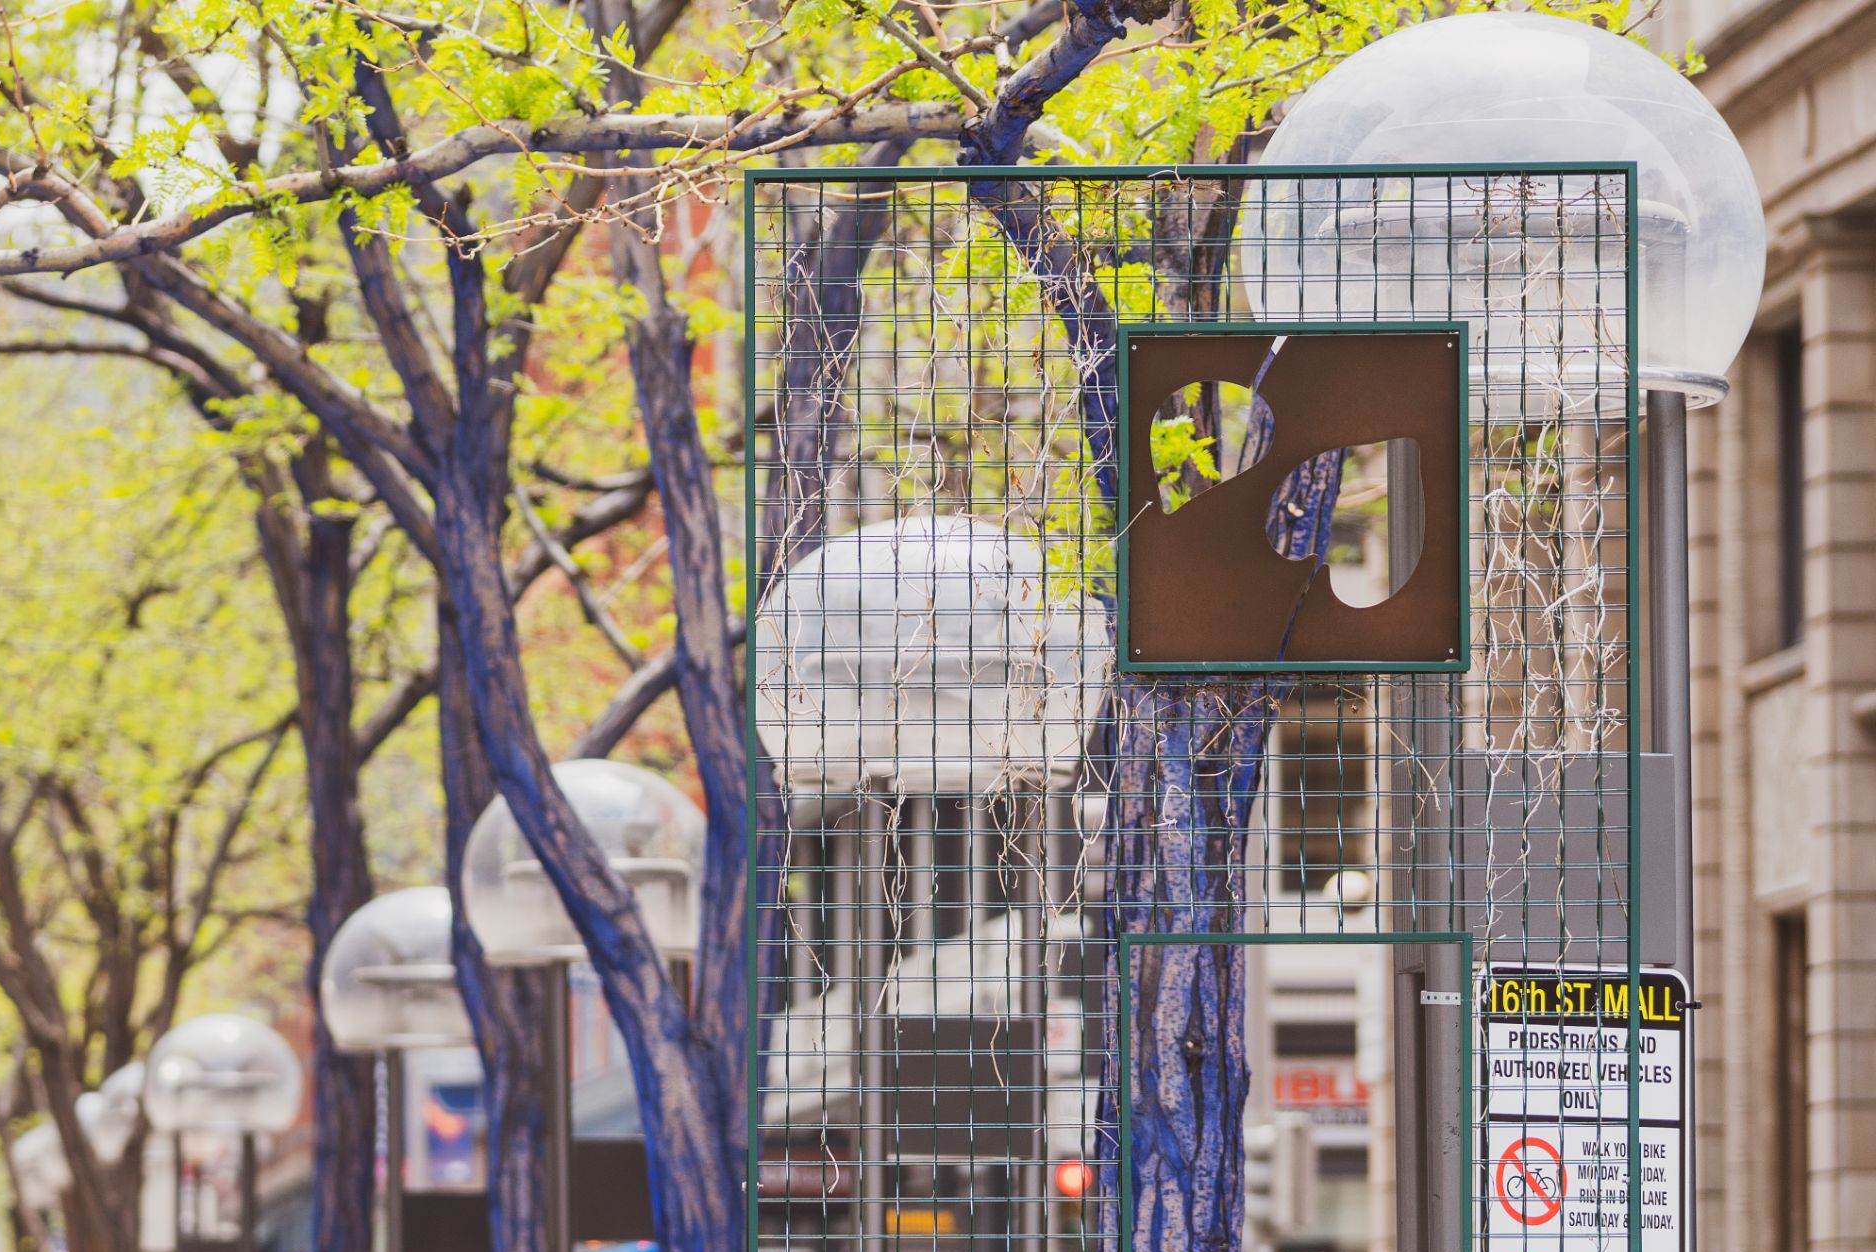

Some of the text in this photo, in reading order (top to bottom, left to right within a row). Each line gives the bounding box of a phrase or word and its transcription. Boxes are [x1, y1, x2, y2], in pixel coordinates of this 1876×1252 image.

[1491, 979, 1546, 1017] 16th
[1605, 984, 1680, 1021] MALL
[1508, 1031, 1618, 1052] PEDESTRIANS
[1493, 1059, 1672, 1084] AUTHORZED VEHCLES
[1643, 1143, 1666, 1159] BIKE
[1640, 1166, 1667, 1183] IDAY.
[1642, 1190, 1667, 1206] LANE
[1640, 1214, 1674, 1230] UNDAY.
